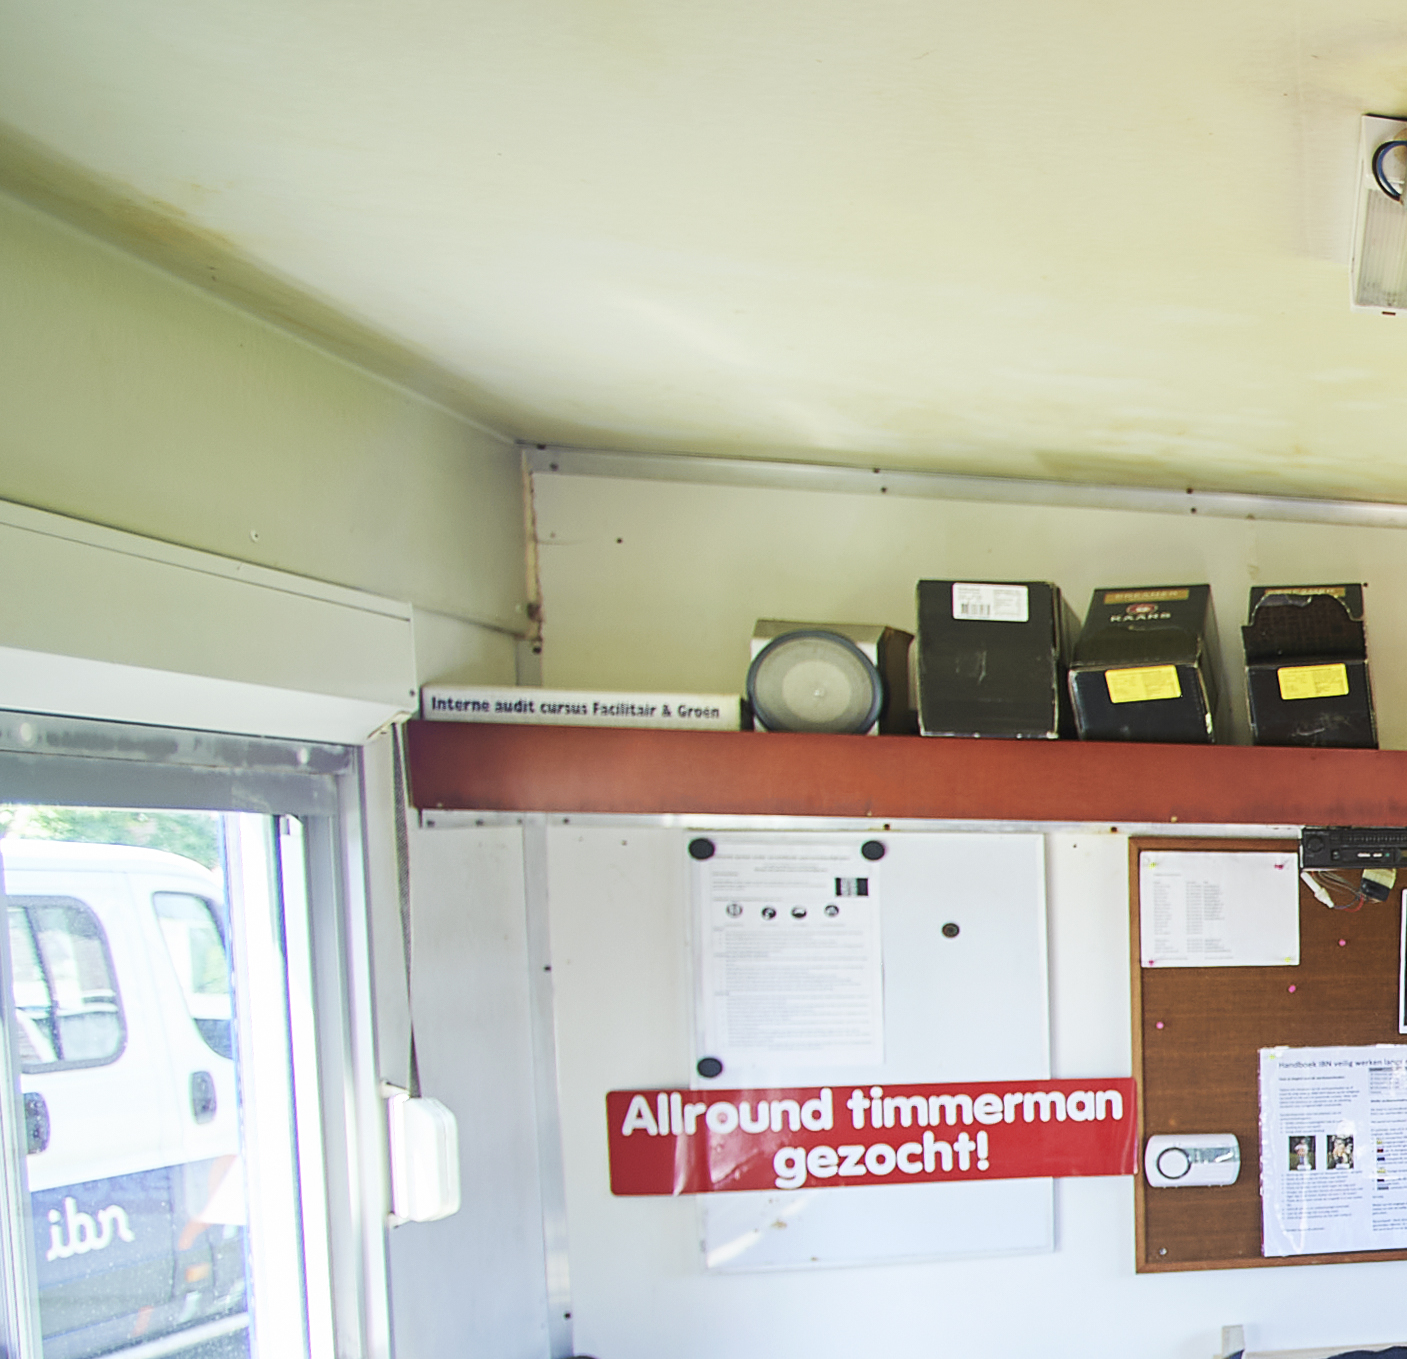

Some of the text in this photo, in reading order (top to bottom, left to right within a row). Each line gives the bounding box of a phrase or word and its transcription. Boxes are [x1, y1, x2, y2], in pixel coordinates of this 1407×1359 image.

[432, 696, 490, 712] Interne
[494, 698, 535, 714] audit
[540, 701, 588, 715] cursus
[593, 702, 657, 717] Facilitair
[677, 704, 720, 719] Groen
[621, 1087, 1123, 1136] Allround timmerman
[773, 1131, 990, 1189] gezocht!
[46, 1196, 136, 1261] ibn
